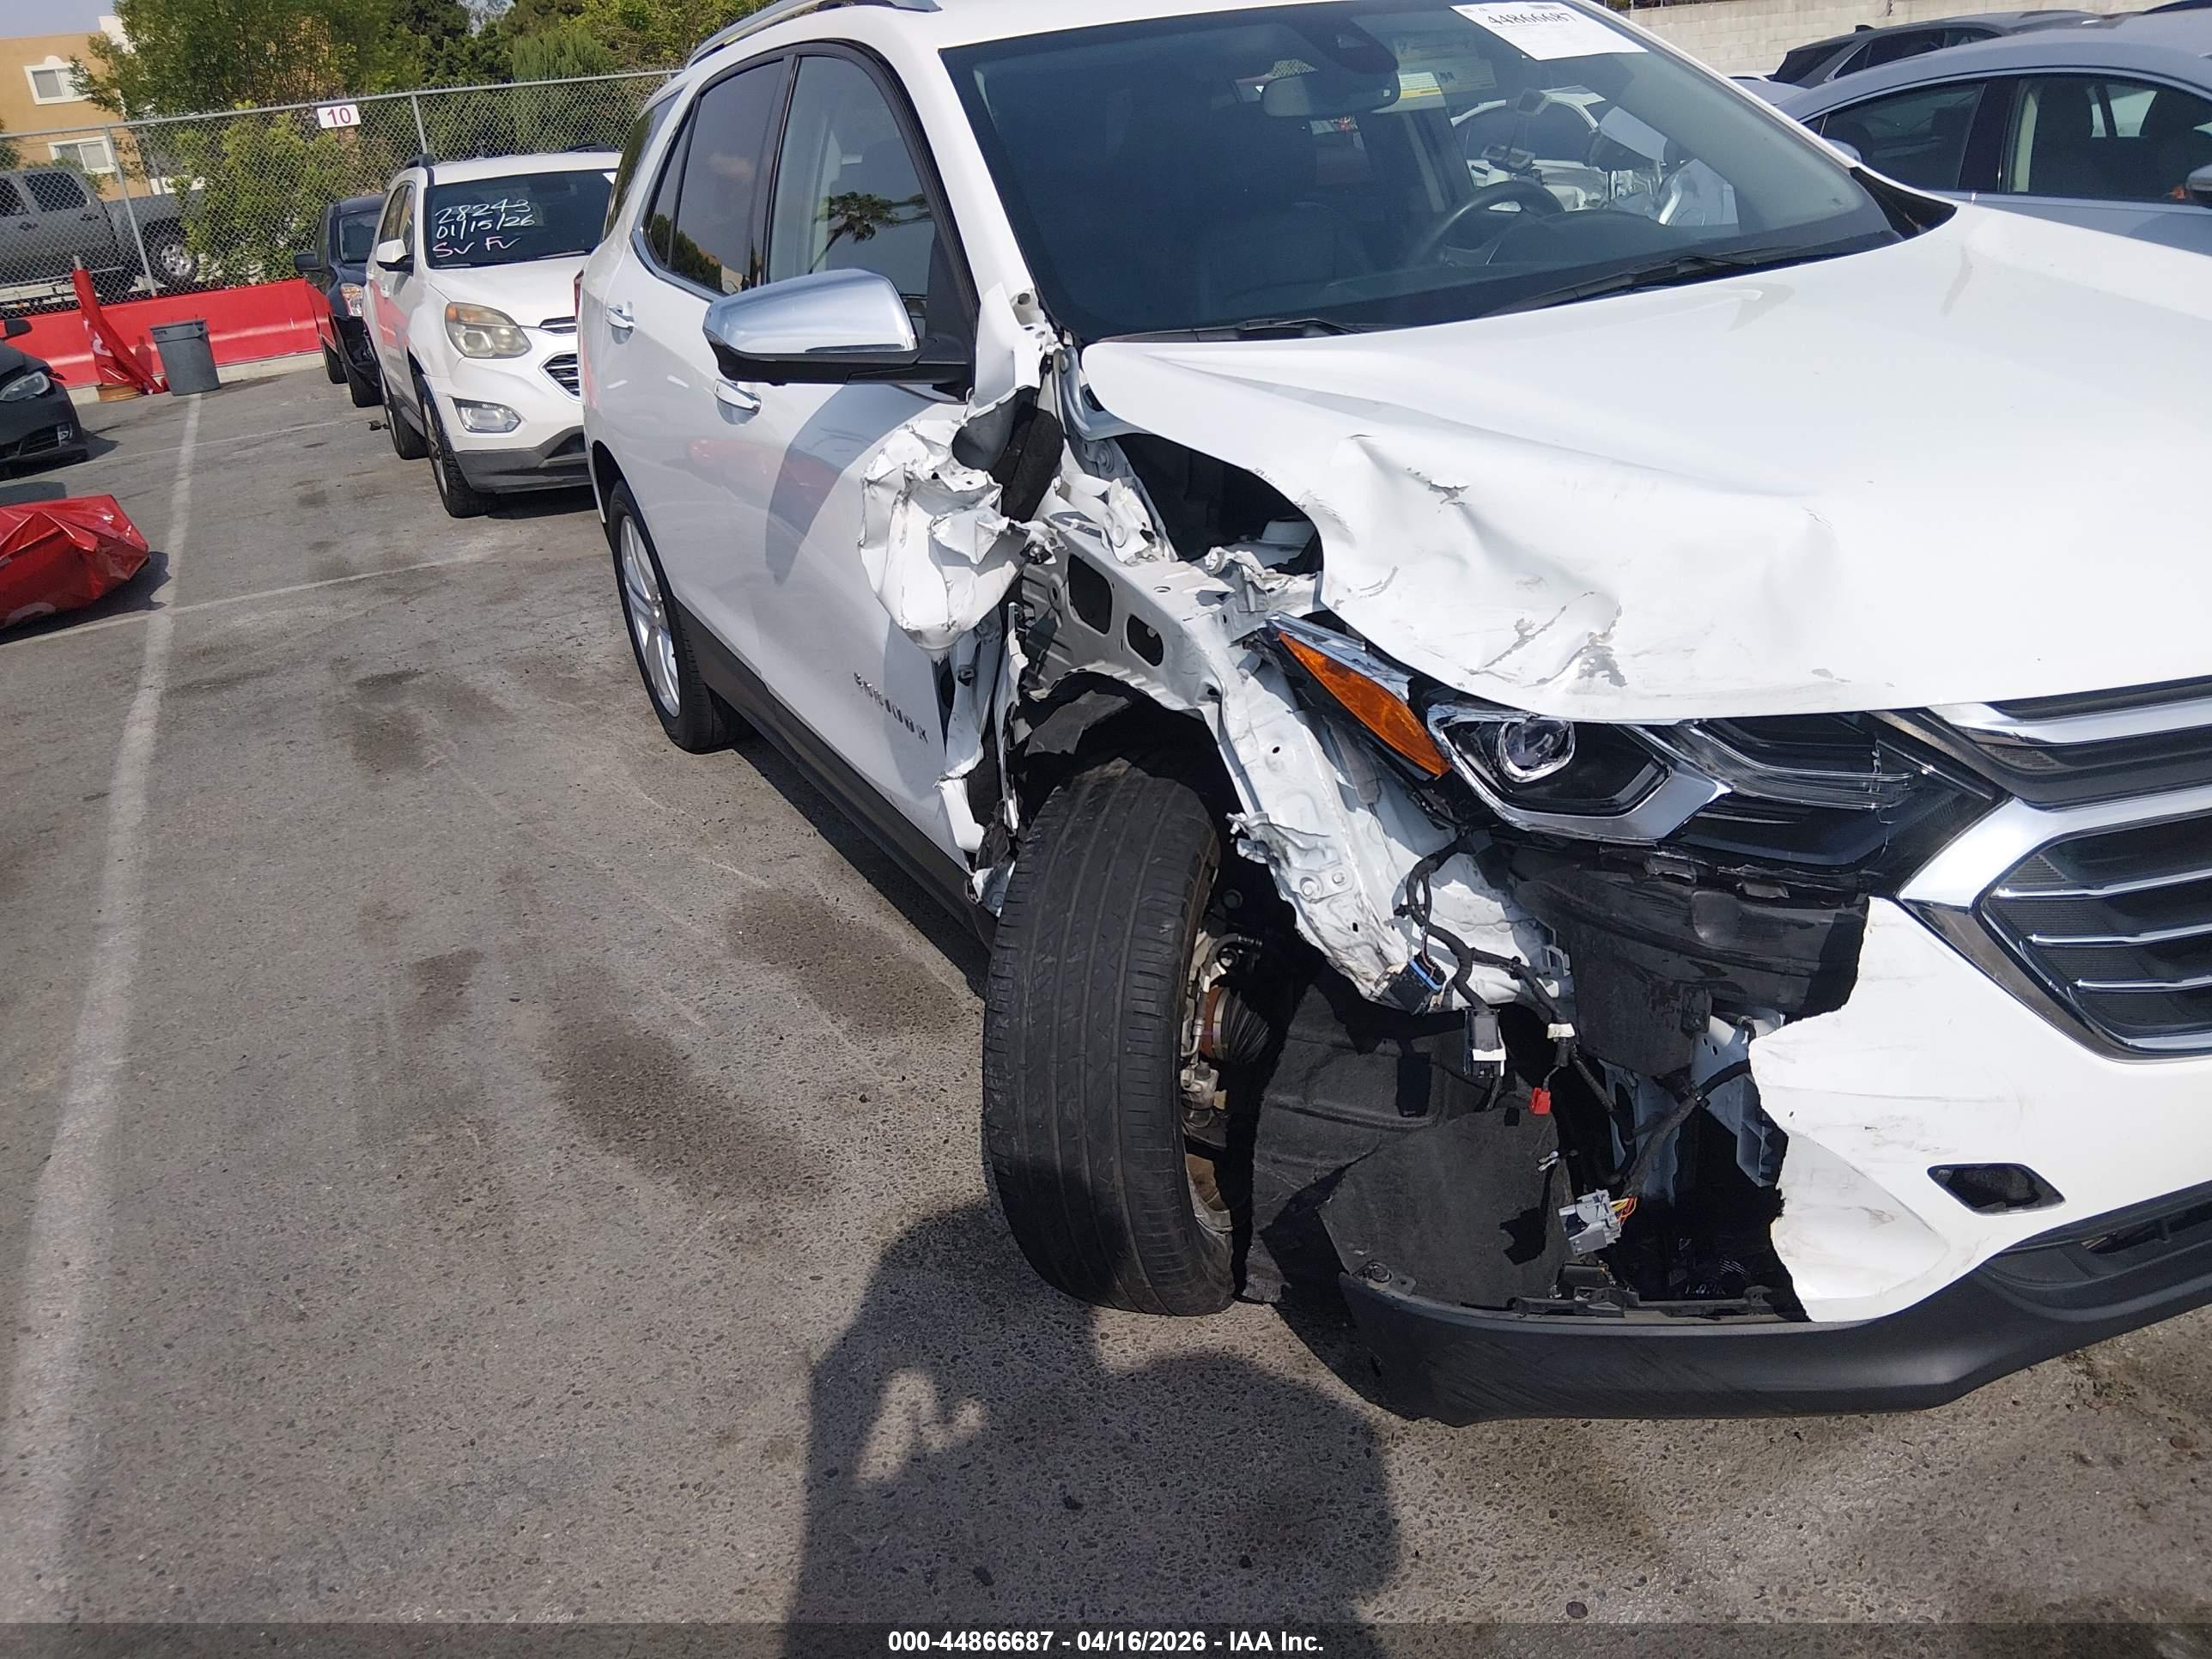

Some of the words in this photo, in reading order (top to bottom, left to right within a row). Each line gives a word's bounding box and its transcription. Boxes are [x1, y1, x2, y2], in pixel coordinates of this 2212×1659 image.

[1488, 13, 1577, 26] 44866687
[327, 107, 351, 125] 10
[434, 198, 531, 224] 28243
[436, 213, 535, 240] 01/15/26
